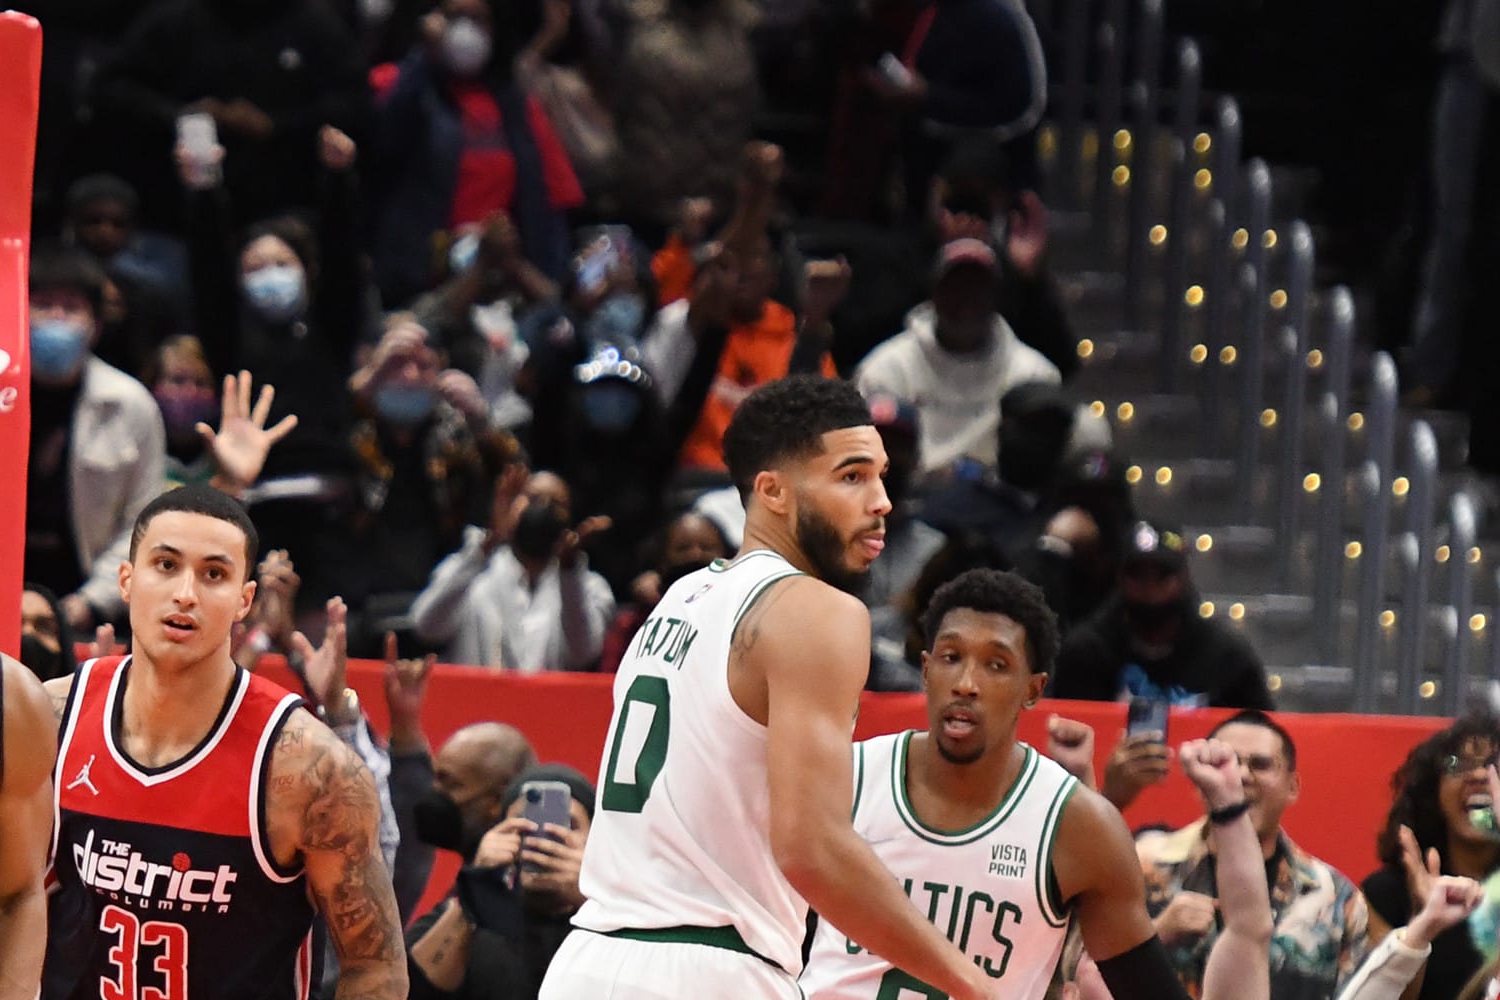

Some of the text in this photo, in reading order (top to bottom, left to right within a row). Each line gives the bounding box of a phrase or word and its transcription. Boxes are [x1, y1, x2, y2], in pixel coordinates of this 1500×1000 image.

[635, 616, 698, 670] TATUM
[602, 674, 671, 813] 0
[73, 828, 238, 903] district
[102, 839, 131, 857] THE
[988, 861, 1026, 879] PRINT
[991, 844, 1027, 865] VISTA
[846, 878, 1023, 979] TICS
